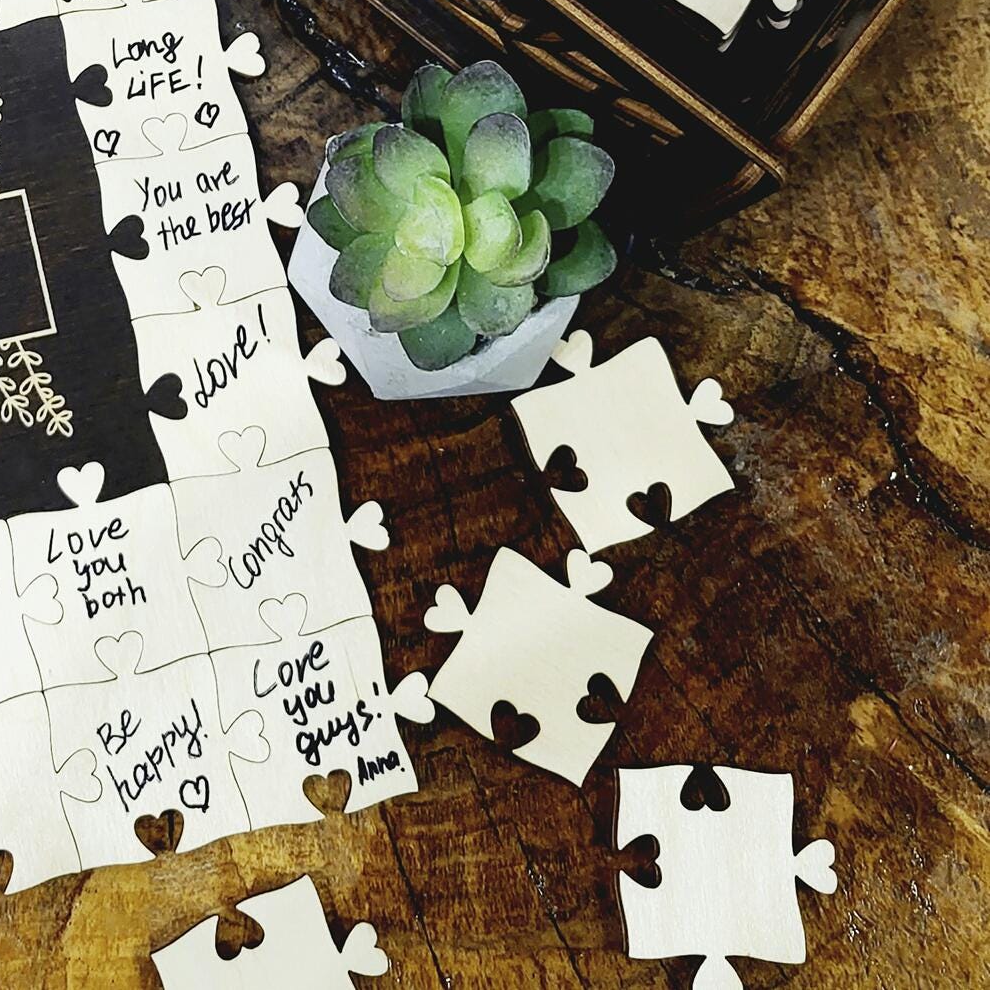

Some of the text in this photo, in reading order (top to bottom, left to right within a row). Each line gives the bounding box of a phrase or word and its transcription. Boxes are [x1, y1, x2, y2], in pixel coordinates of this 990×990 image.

[111, 31, 184, 70] Long
[196, 161, 240, 193] are
[157, 197, 258, 251] the best
[194, 303, 272, 408] Love!
[47, 517, 129, 564] Love
[228, 470, 314, 590] Congrats
[73, 552, 127, 593] you
[80, 576, 148, 619] both
[252, 640, 330, 699] Love
[282, 679, 336, 726] you
[294, 681, 383, 767] guys!
[105, 697, 209, 814] happy!
